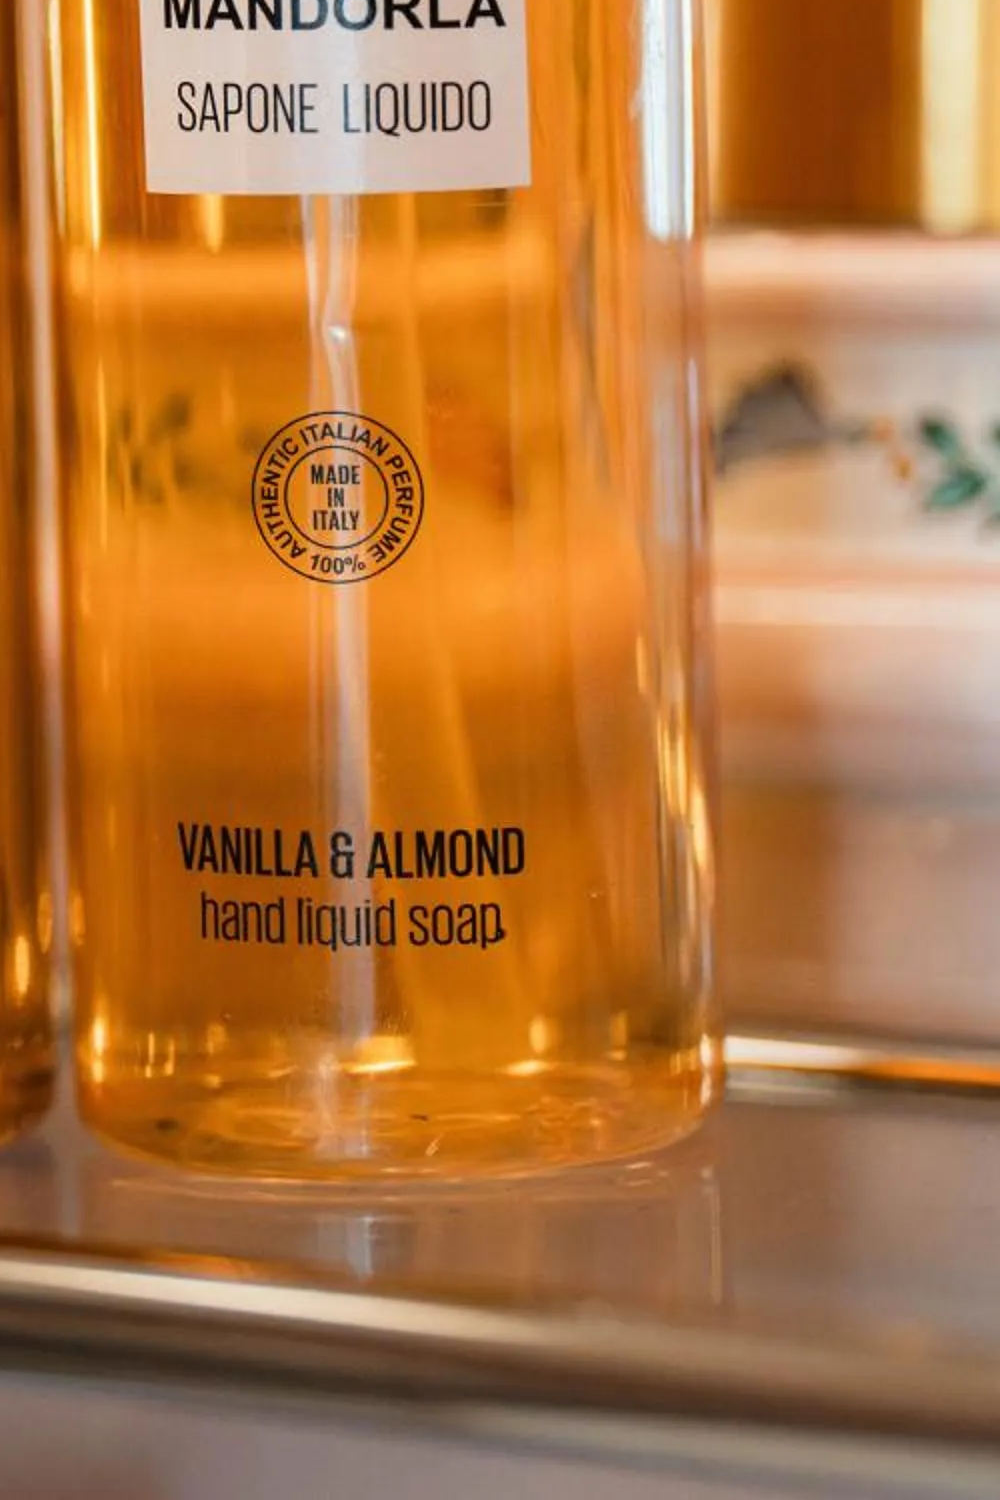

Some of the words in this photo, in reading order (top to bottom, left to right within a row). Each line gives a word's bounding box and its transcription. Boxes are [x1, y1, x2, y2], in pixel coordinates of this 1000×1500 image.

[177, 81, 319, 133] SAPONE
[343, 81, 491, 137] LIQUIDO
[261, 438, 306, 559] AUTHENTIC
[299, 421, 390, 457] ITALIAN
[367, 455, 413, 563] PERFUME
[311, 465, 361, 485] MADE
[327, 488, 344, 508] IN
[313, 510, 360, 531] ITALY
[310, 554, 366, 575] 100%
[177, 821, 318, 878] VANILLA
[330, 831, 354, 879] &
[366, 827, 525, 879] ALMOND
[200, 891, 285, 944] hand
[297, 897, 396, 951] liquid
[409, 903, 502, 949] soap
